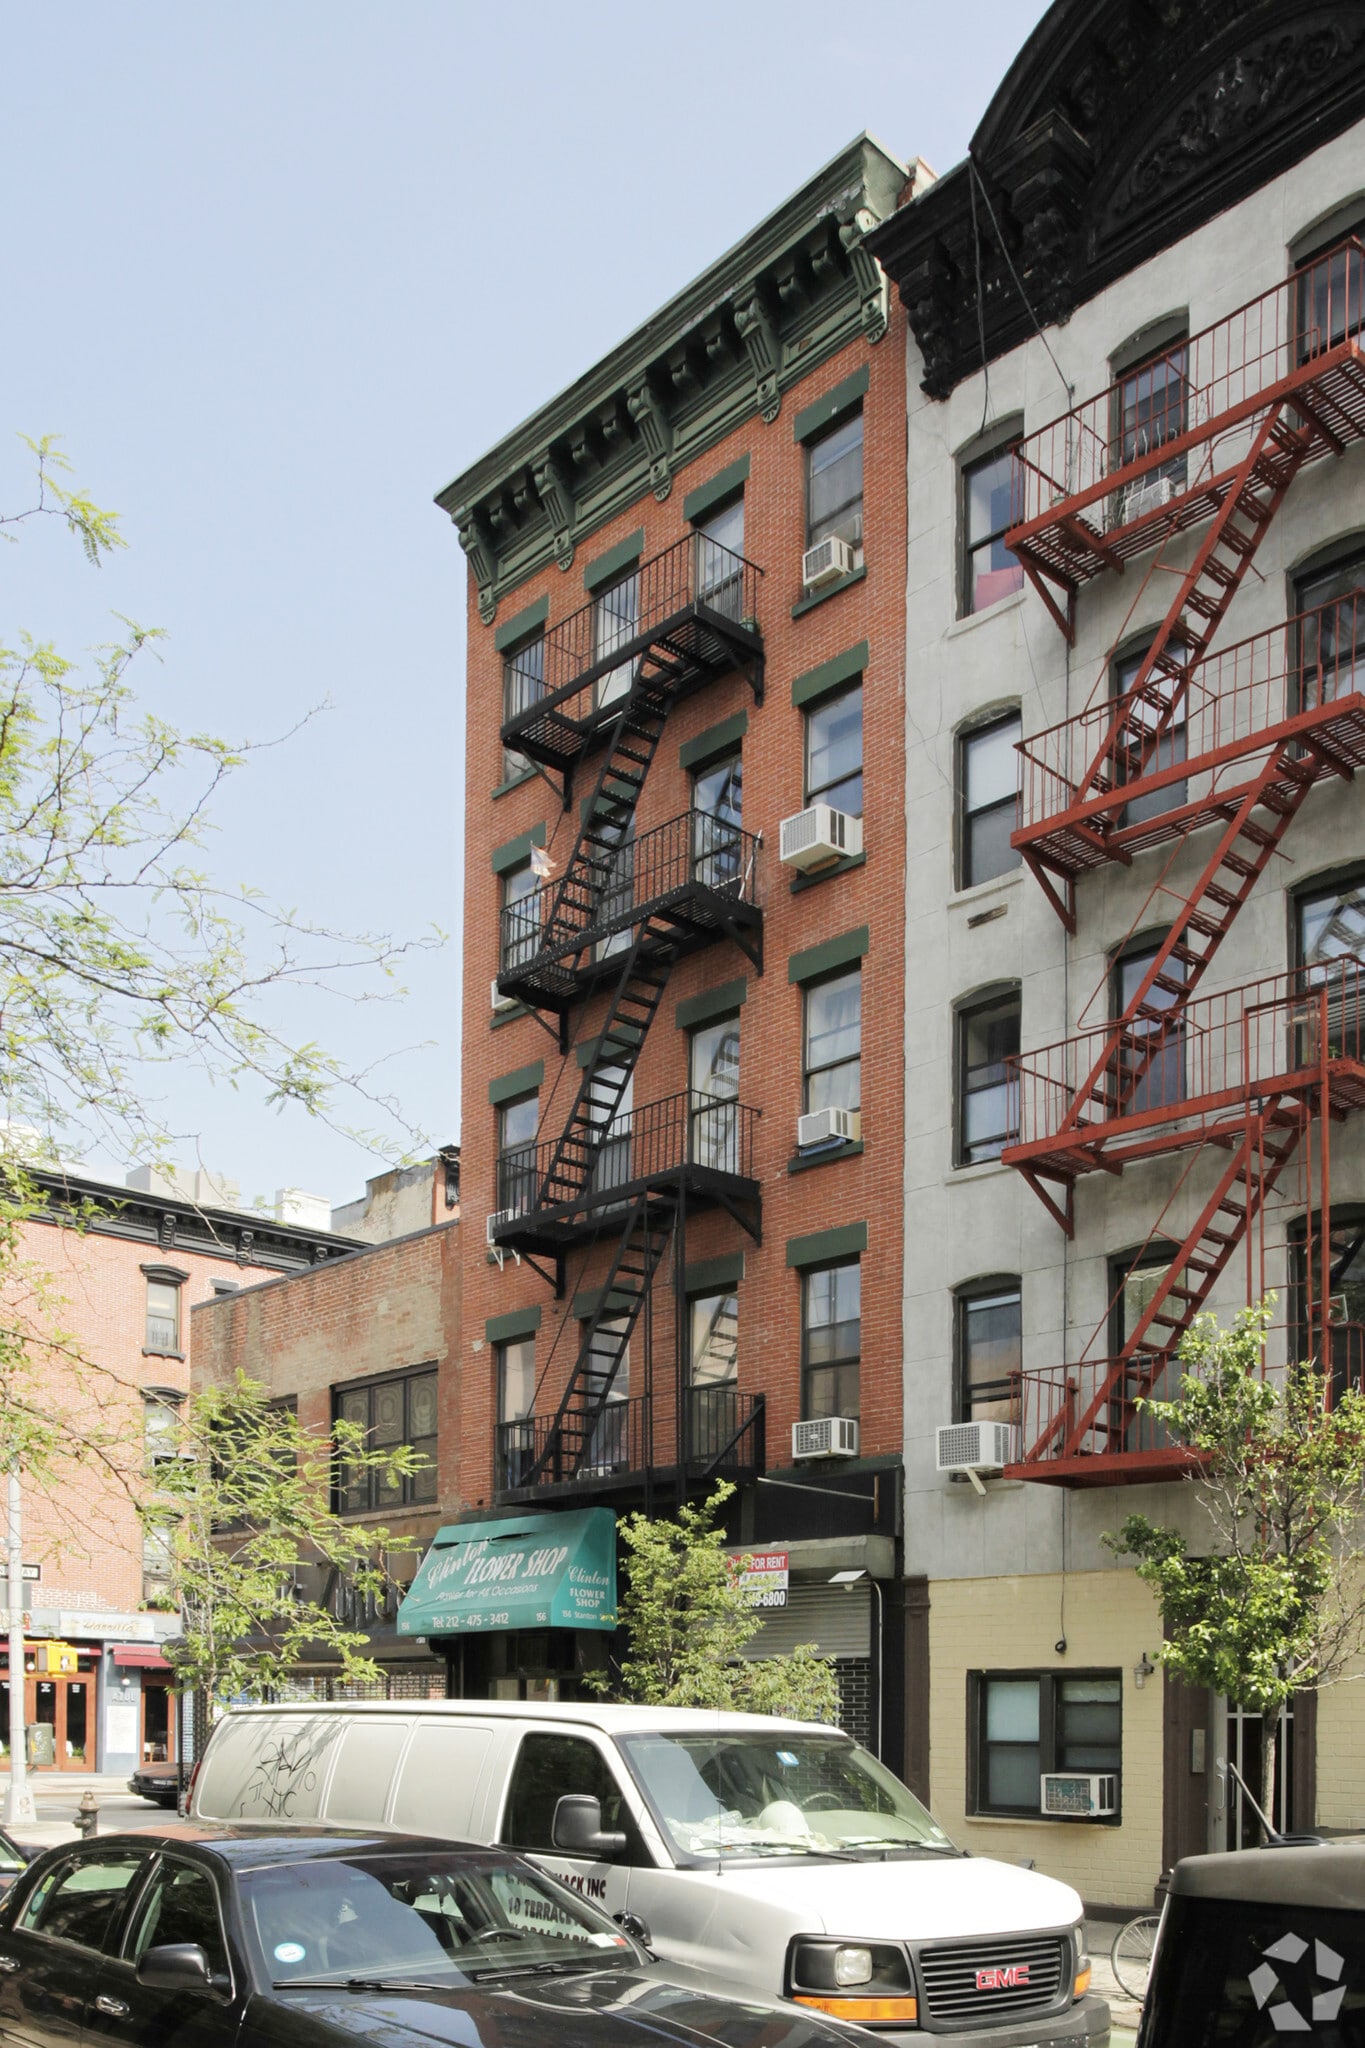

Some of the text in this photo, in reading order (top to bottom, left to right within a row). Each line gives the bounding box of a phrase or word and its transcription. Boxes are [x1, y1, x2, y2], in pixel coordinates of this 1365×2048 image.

[427, 1536, 489, 1589] Clinton
[464, 1547, 568, 1585] FLOWER SHOP
[751, 1558, 766, 1571] FOR
[767, 1555, 786, 1569] RENT
[568, 1566, 610, 1586] Clinton
[569, 1587, 605, 1599] FLOWER
[576, 1598, 600, 1608] SHOP
[587, 1878, 607, 1899] INC
[508, 1896, 521, 1915] 10
[975, 1965, 1030, 1990] GMC
